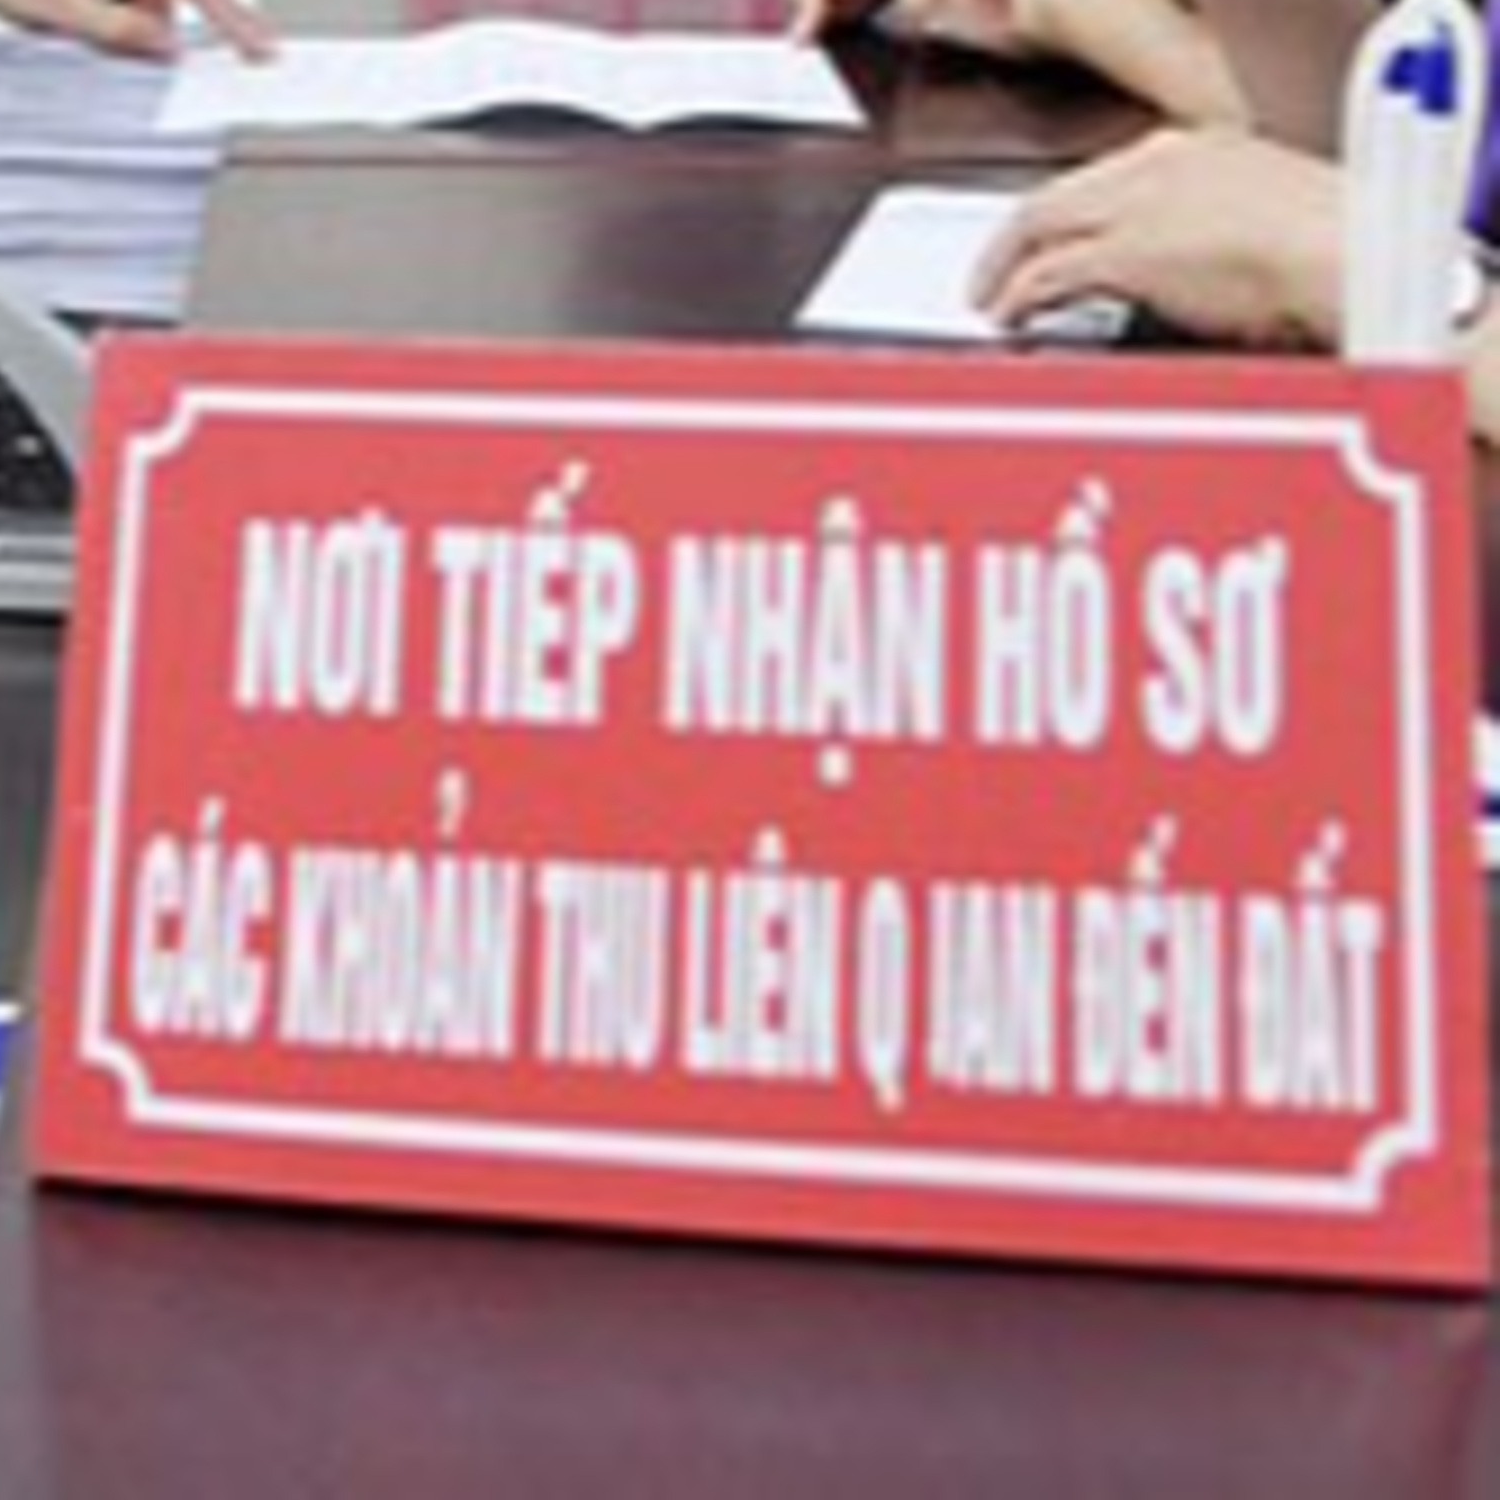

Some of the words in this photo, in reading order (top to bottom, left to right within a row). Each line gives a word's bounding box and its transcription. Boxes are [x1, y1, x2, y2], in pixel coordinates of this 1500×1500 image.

[236, 512, 404, 713] NƠI
[434, 463, 638, 722] TIẾP
[667, 500, 944, 781] NHẬN
[978, 482, 1109, 746] HỒ
[1143, 539, 1285, 752] SƠ
[133, 800, 270, 1037] CÁC
[281, 774, 520, 1054] KHOẢN
[538, 862, 666, 1065] THU
[685, 831, 838, 1076] LIÊN
[1075, 822, 1219, 1098] ĐẾN
[1241, 827, 1380, 1109] ĐẤT
